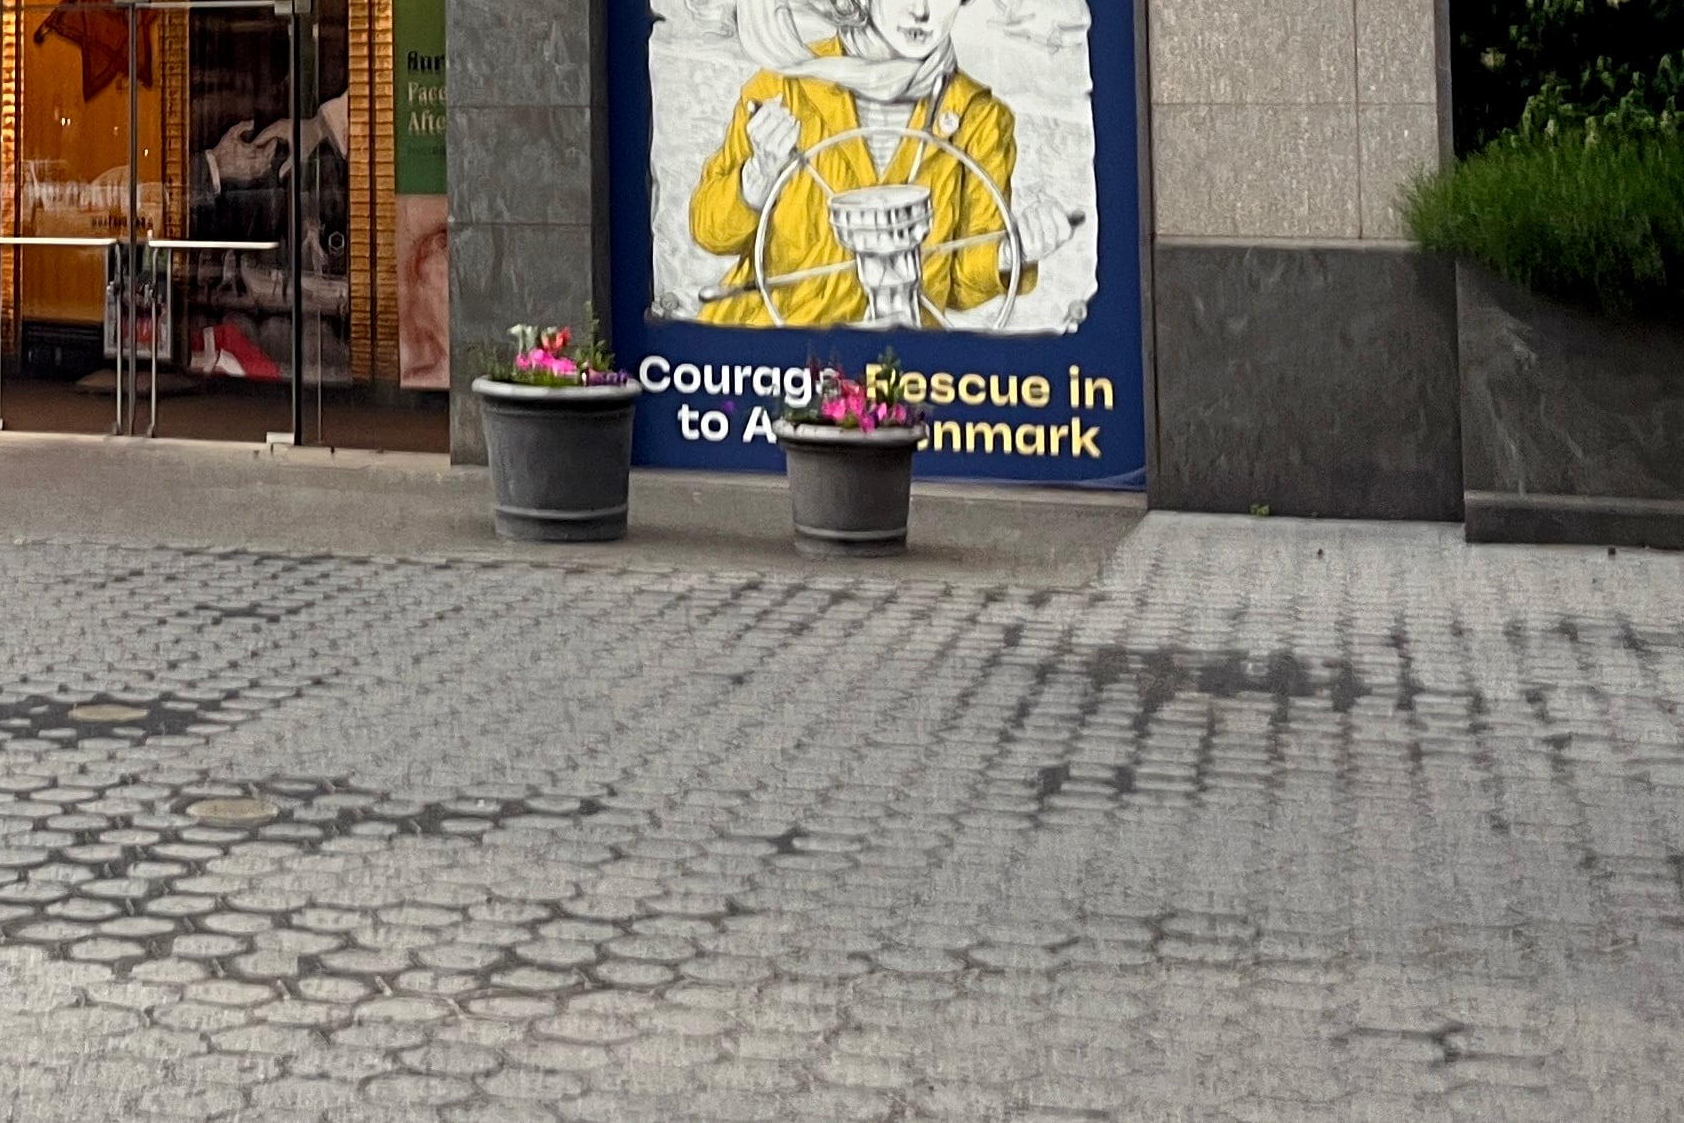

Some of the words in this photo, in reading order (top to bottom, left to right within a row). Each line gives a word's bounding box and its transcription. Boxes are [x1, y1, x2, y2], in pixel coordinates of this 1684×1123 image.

[865, 363, 1051, 409] Rescue
[1068, 364, 1114, 411] in
[676, 403, 729, 443] to
[917, 416, 1102, 459] nmark
